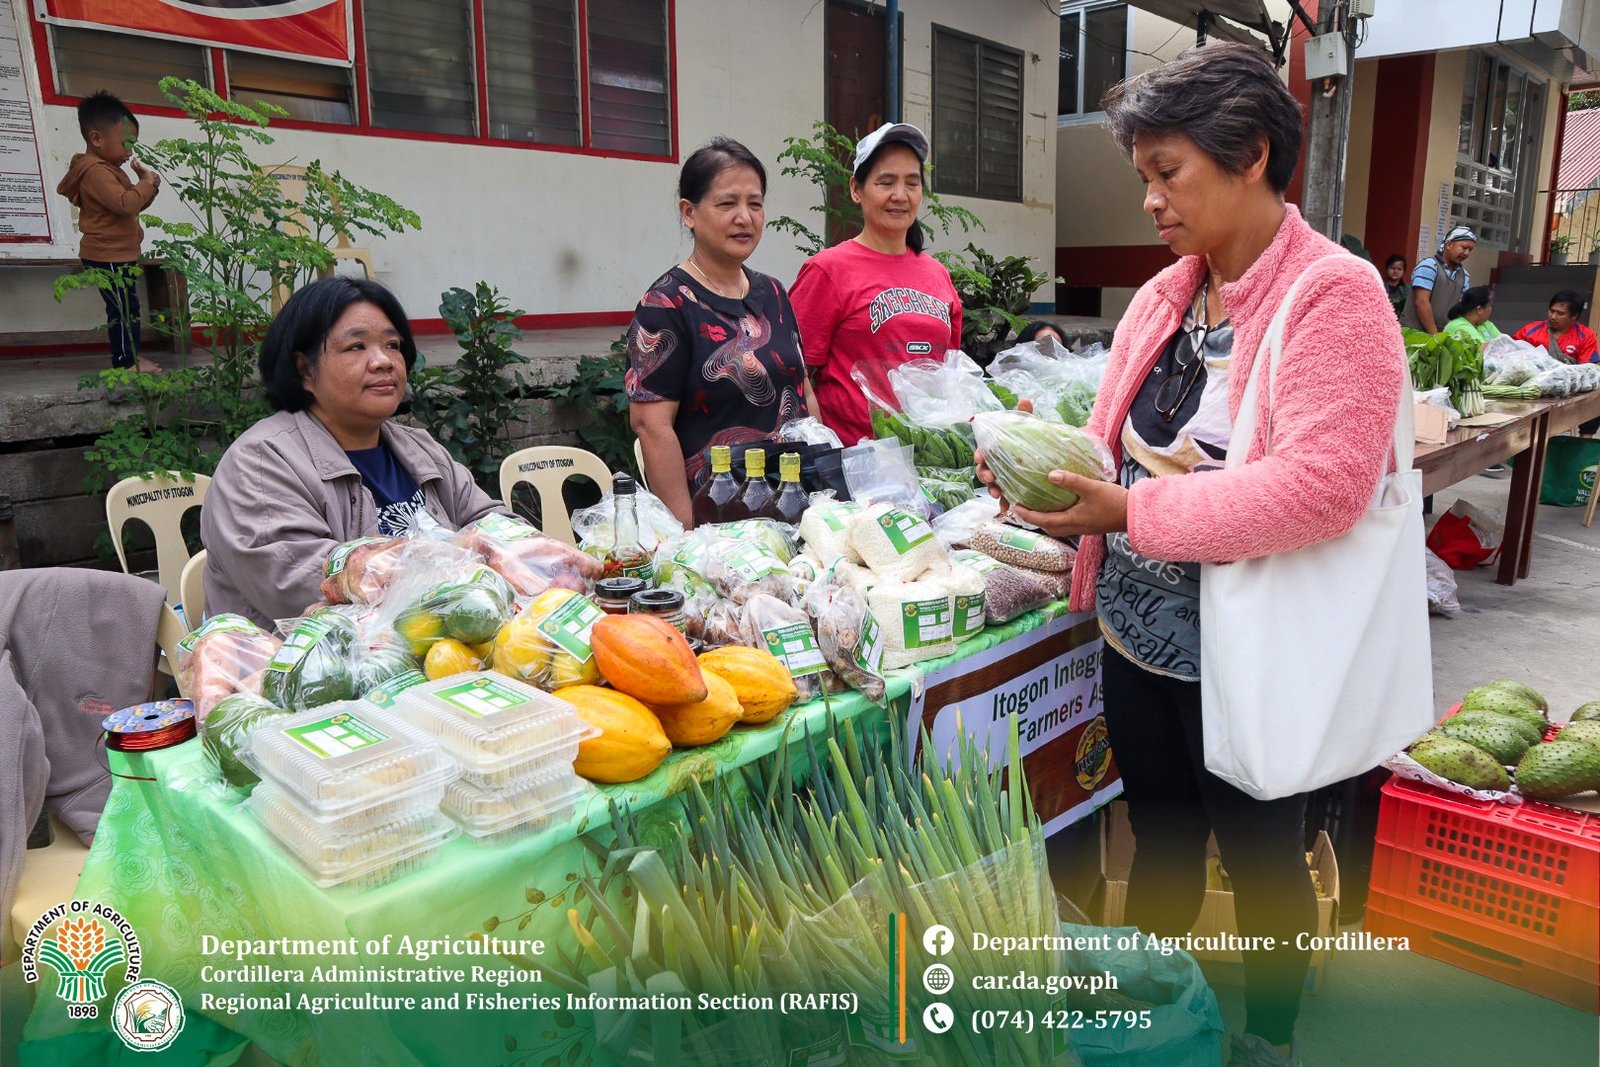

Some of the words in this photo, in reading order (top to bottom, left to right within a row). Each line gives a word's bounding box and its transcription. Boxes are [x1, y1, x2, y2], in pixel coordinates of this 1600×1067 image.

[870, 287, 952, 334] SKECHER
[518, 460, 549, 473] MUNICIPALITY
[549, 459, 556, 468] OF
[555, 458, 575, 467] ITOGON
[126, 489, 163, 507] MUNICIPALITY
[163, 488, 171, 499] OF
[171, 486, 194, 498] ITOGON
[992, 675, 1049, 722] Itogon
[1018, 694, 1083, 742] Farmers
